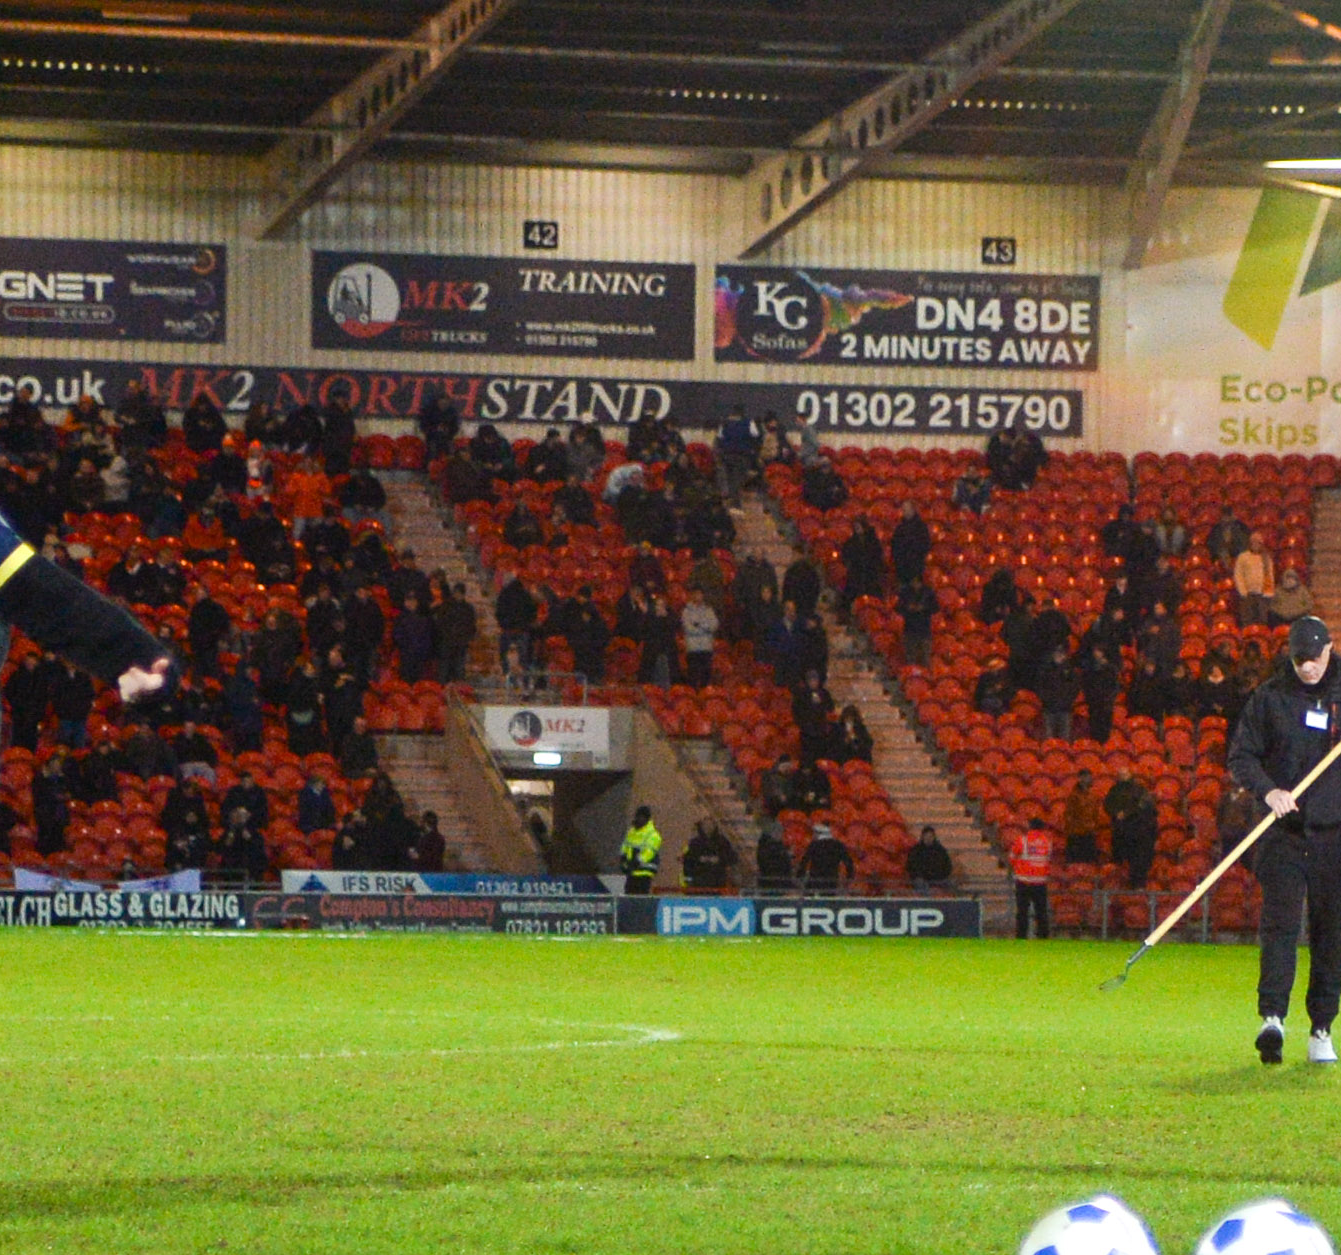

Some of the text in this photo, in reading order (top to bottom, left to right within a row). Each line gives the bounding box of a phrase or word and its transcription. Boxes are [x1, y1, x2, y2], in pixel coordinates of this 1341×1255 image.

[527, 223, 557, 246] 42
[984, 240, 1014, 262] 43
[401, 280, 490, 313] MK2
[519, 268, 667, 297] TRAINING
[752, 280, 809, 330] KC
[916, 298, 1091, 334] DN4 8DE
[752, 333, 809, 350] Sofas
[840, 335, 1092, 365] 2 MINUTES AWAY
[140, 367, 255, 411] MK2
[796, 390, 1071, 430] 01302 215790
[1218, 418, 1319, 450] Skips
[545, 719, 586, 733] MK2
[342, 876, 417, 894] IFS RISK
[54, 892, 240, 920] GLASS & GLAZING
[662, 906, 945, 936] IPM GROUP
